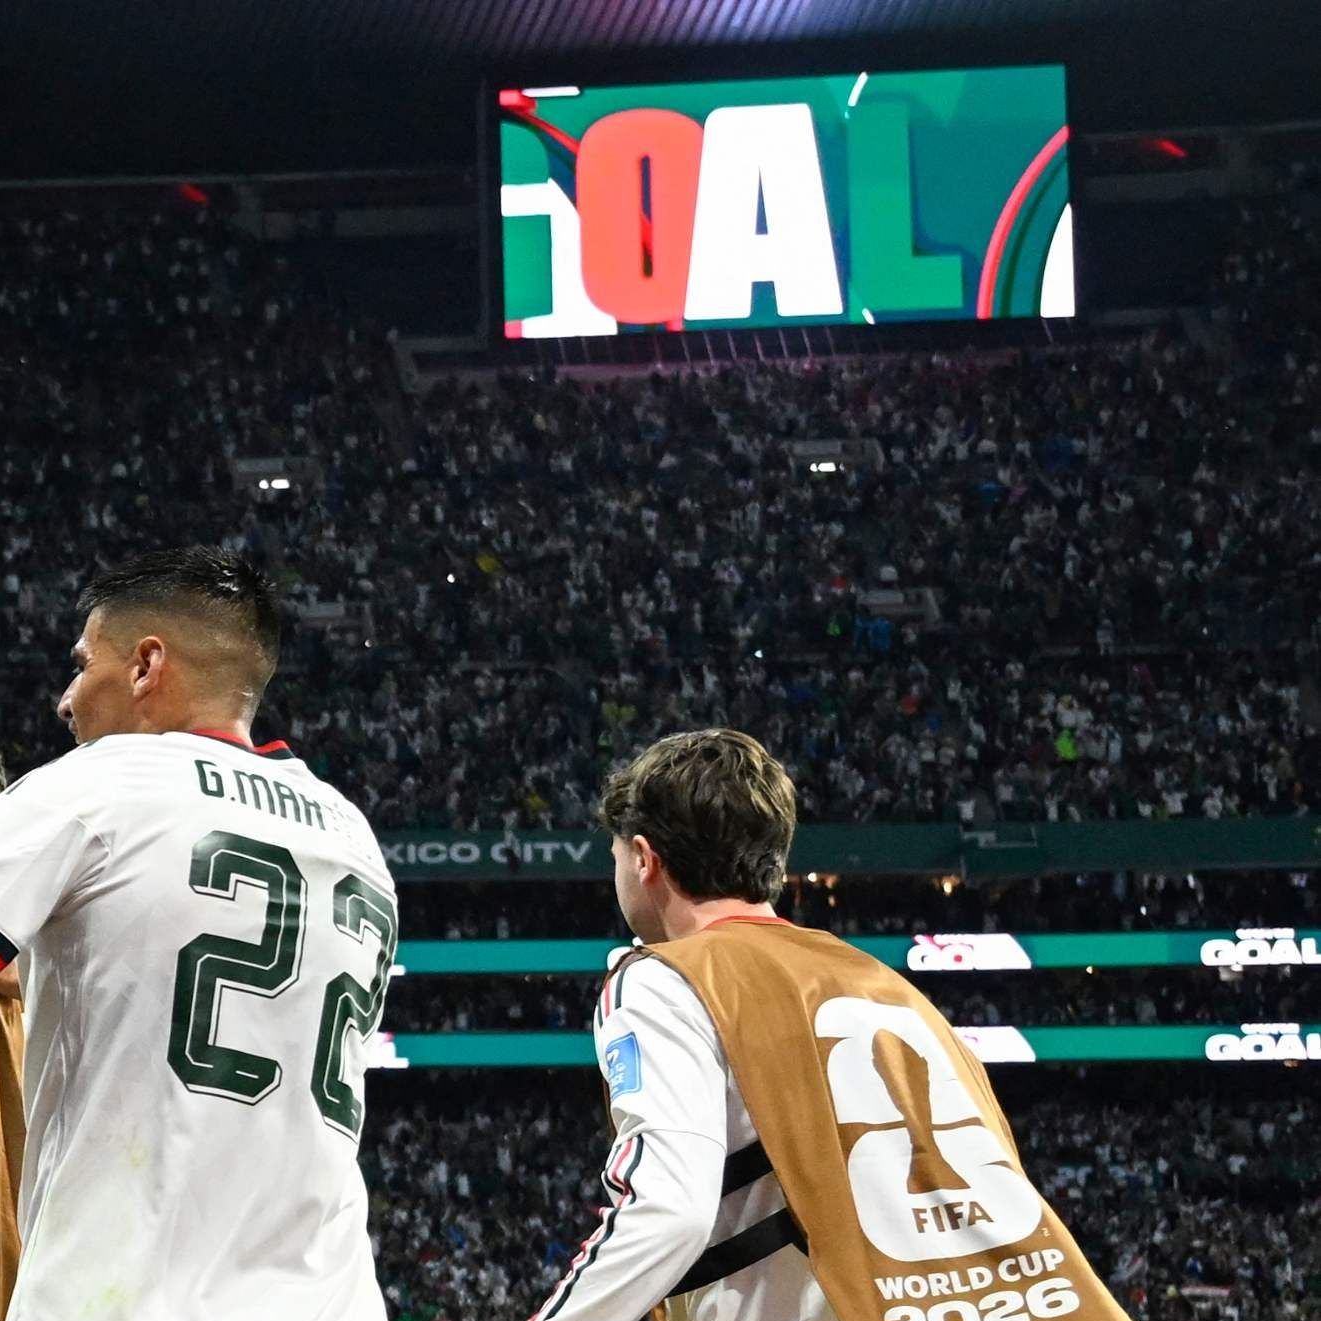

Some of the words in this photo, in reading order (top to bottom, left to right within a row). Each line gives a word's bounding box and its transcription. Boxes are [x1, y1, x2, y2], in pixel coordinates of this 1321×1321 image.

[1200, 937, 1321, 966] GOAL
[167, 830, 399, 1144] 22
[911, 1200, 994, 1234] FIFA
[874, 1266, 993, 1301] WORLD
[997, 1248, 1065, 1283] CUP
